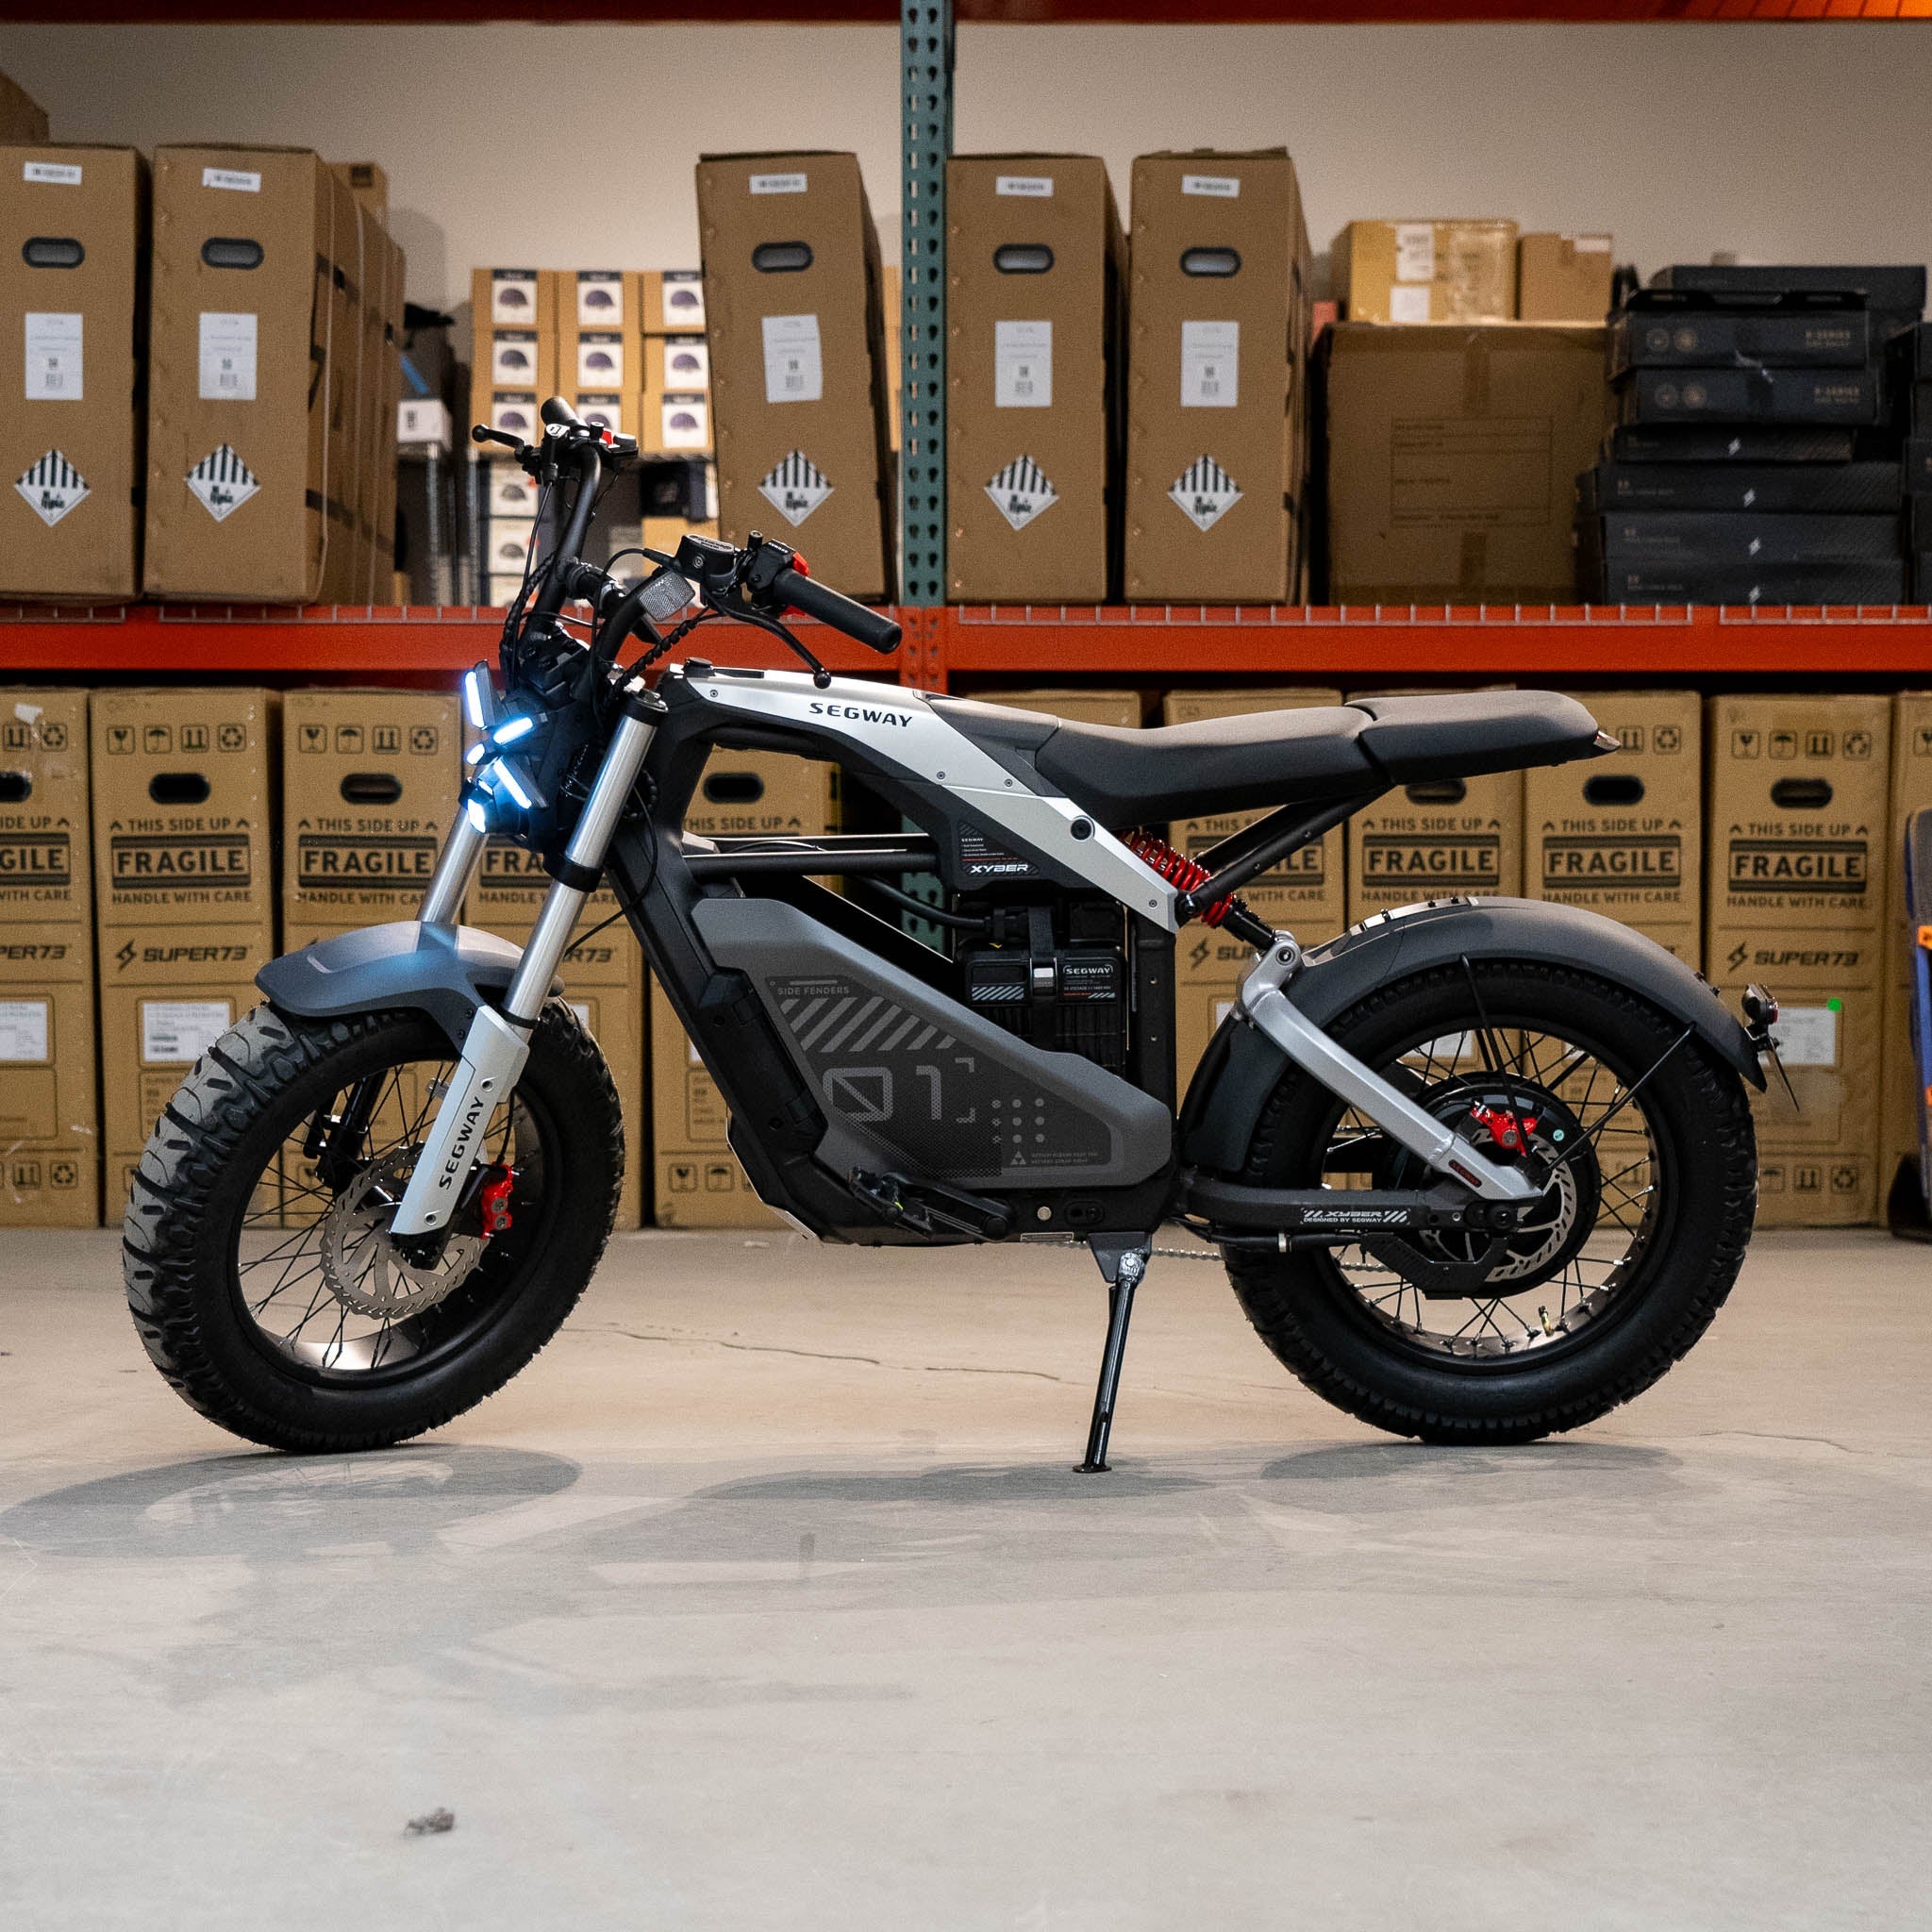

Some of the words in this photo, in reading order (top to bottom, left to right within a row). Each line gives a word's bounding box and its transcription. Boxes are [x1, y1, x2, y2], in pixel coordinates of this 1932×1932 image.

[808, 702, 912, 727] SEGWAY
[0, 816, 25, 830] IDE
[30, 816, 51, 829] UP
[128, 819, 162, 831] THIS
[170, 818, 204, 831] SIDE
[209, 818, 231, 830] UP
[316, 819, 354, 831] THIS
[358, 819, 393, 832] SIDE
[398, 820, 418, 832] UP
[721, 817, 756, 830] SIDE
[761, 817, 782, 829] UP
[1205, 819, 1239, 831] THIS
[1382, 818, 1417, 831] THIS
[1422, 818, 1456, 831] SIDE
[1463, 818, 1483, 830] UP
[1561, 819, 1600, 832] THIS
[1604, 819, 1638, 832] SIDE
[1641, 819, 1663, 831] UP
[1749, 823, 1783, 836] THIS
[1789, 824, 1823, 836] SIDE
[1829, 824, 1851, 837] UP
[0, 847, 64, 871] GILE
[117, 849, 244, 874] FRAGILE
[304, 850, 431, 874] FRAGILE
[1369, 850, 1493, 873] FRAGILE
[1548, 850, 1674, 874] FRAGILE
[970, 864, 1029, 874] XYBER
[1735, 855, 1861, 878] FRAGILE
[0, 890, 29, 902] ITH
[34, 889, 71, 901] CARE
[112, 891, 171, 905] HANDLE
[174, 891, 211, 904] WITH
[214, 890, 252, 903] CARE
[297, 892, 358, 906] HANDLE
[360, 892, 395, 906] WITH
[479, 891, 537, 904] HANDLE
[1248, 891, 1287, 901] WITH
[1289, 890, 1325, 901] CARE
[1362, 890, 1419, 902] HANDLE
[1542, 891, 1600, 905] HANDLE
[1604, 891, 1640, 905] WITH
[1644, 891, 1681, 904] CARE
[1727, 896, 1783, 908] HANDLE
[1789, 897, 1825, 909] WITH
[1829, 897, 1867, 910] CARE
[142, 946, 248, 962] SUPER73
[1754, 950, 1860, 967] SUPER73
[777, 987, 801, 995] SIDE
[804, 986, 850, 995] FENDERS
[439, 1096, 485, 1191] SEGWAY
